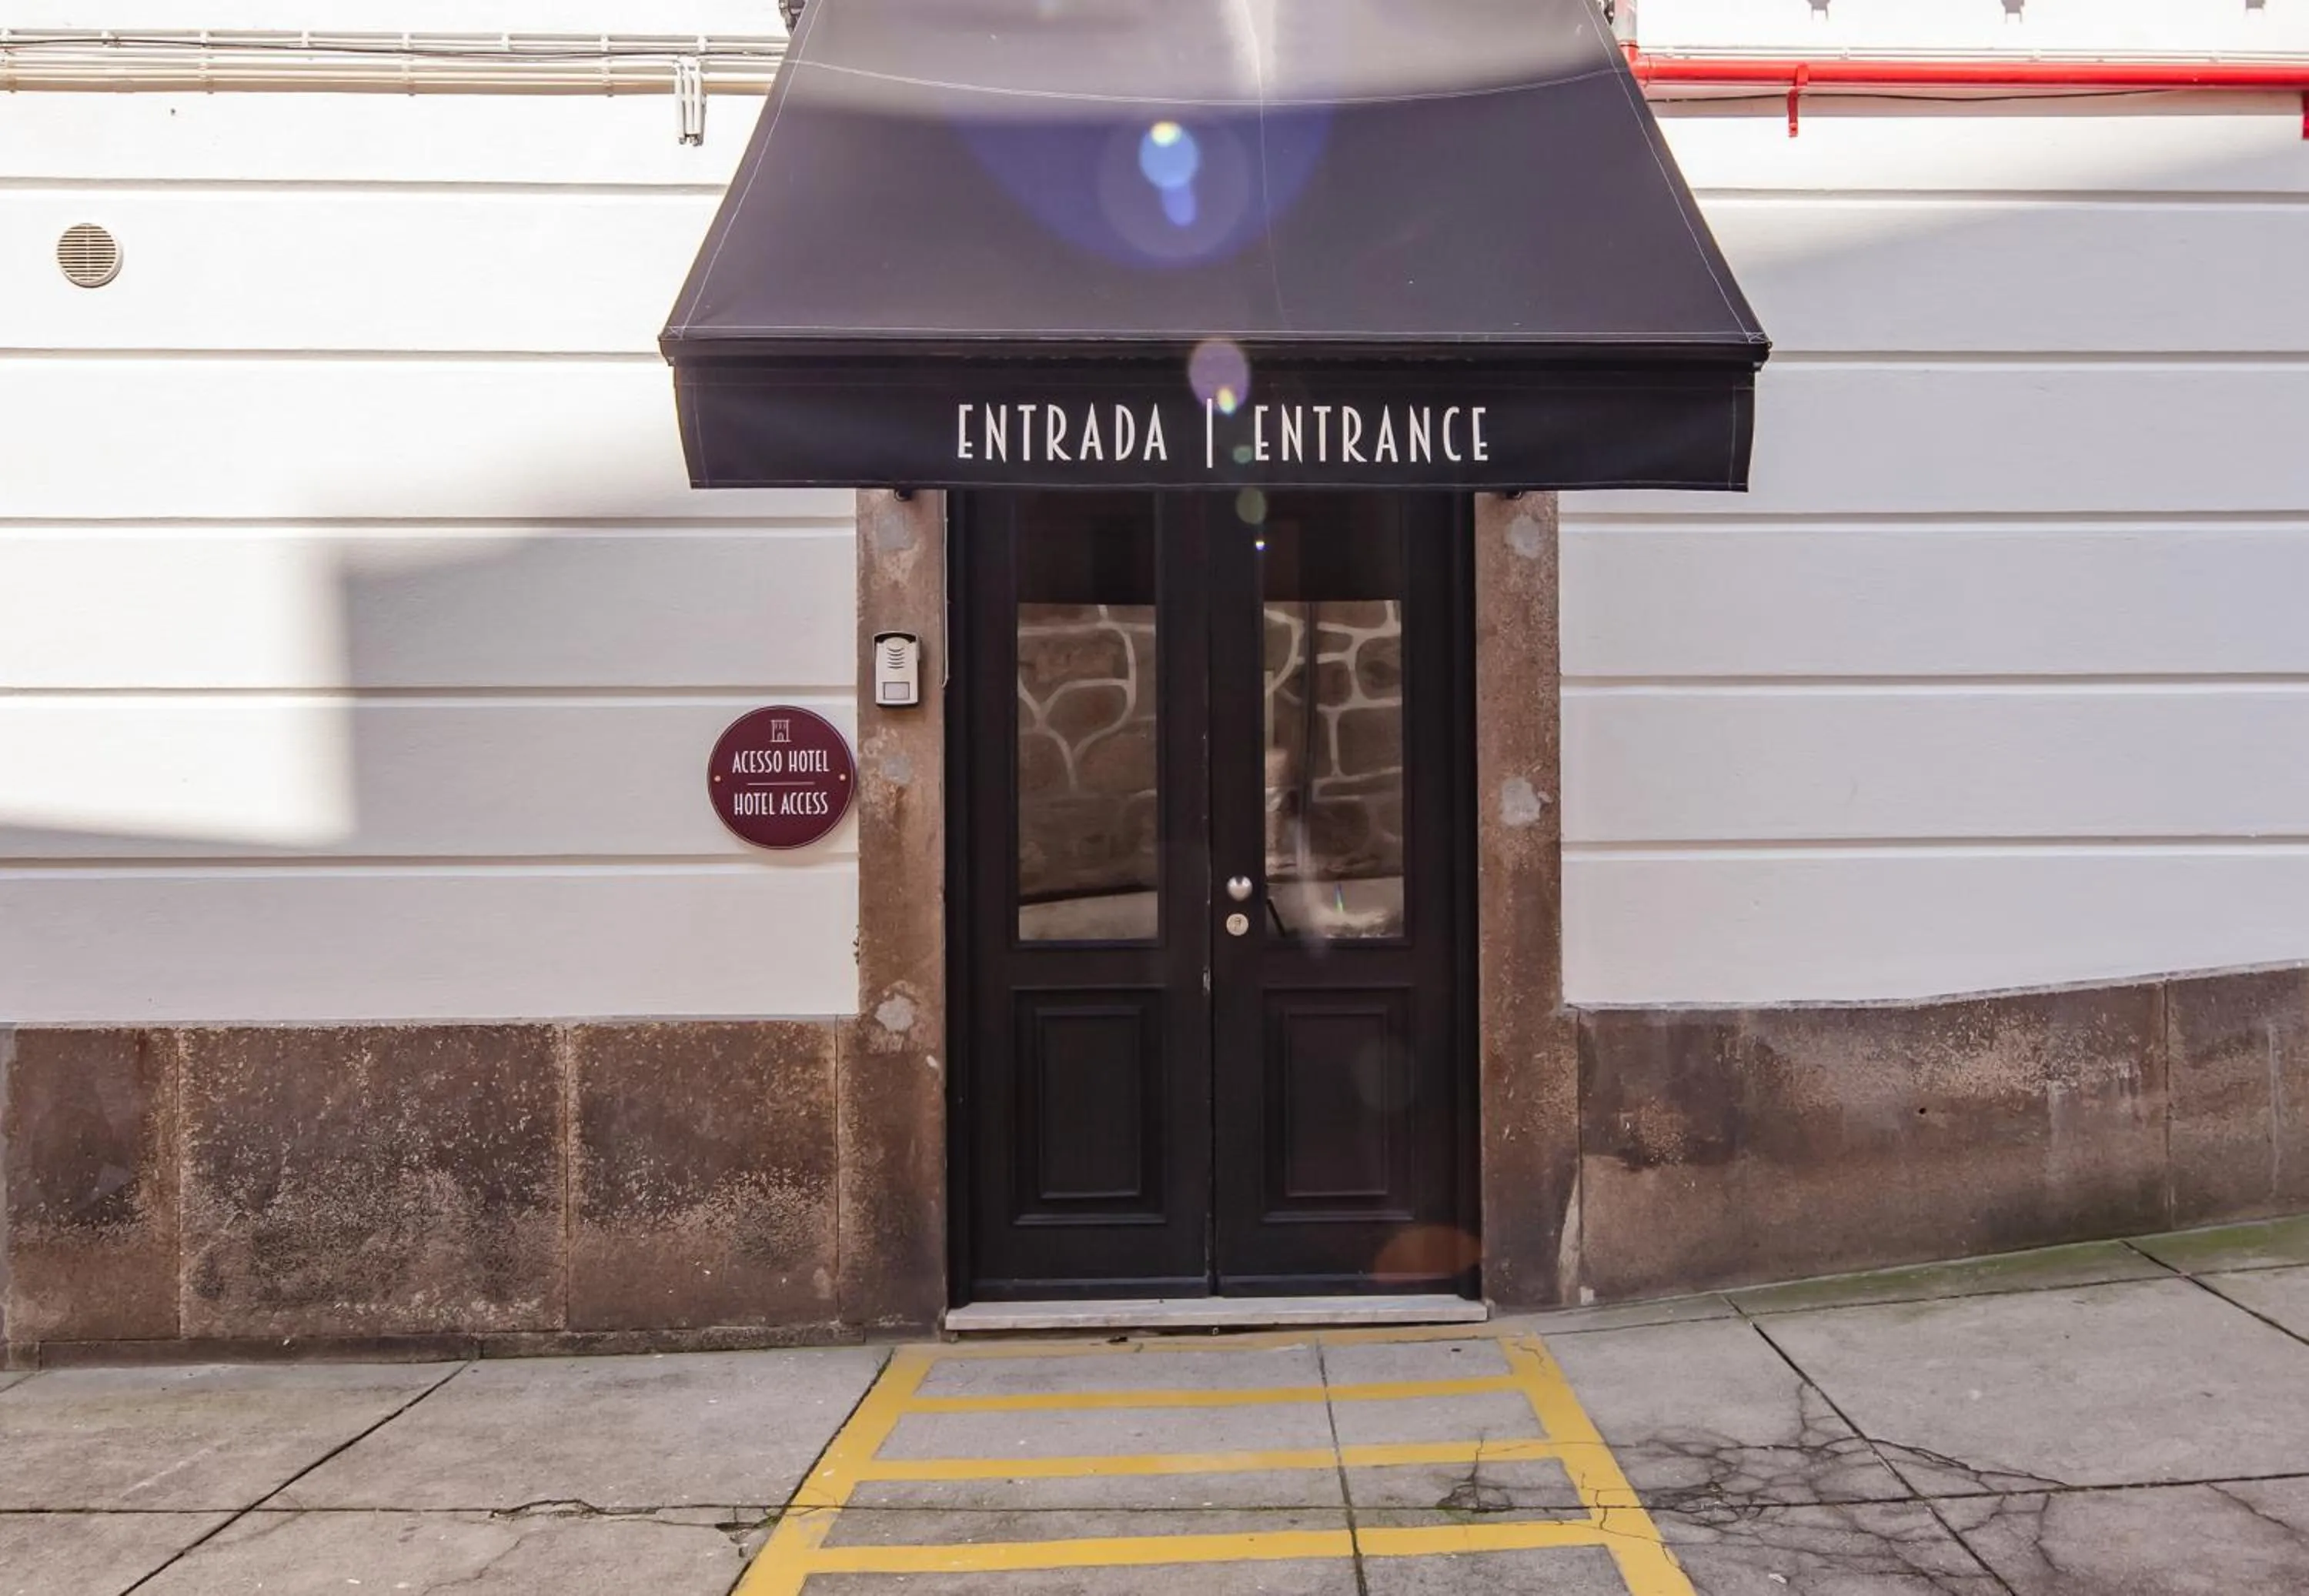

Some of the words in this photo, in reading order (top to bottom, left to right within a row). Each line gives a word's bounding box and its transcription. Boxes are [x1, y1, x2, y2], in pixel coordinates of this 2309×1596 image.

[957, 402, 1168, 462] ENTRADA
[1254, 403, 1489, 463] ENTRANCE
[732, 750, 783, 773] ACESSO
[789, 750, 830, 773] HOTEL
[733, 792, 776, 816] HOTEL
[780, 791, 829, 815] ACCESS
